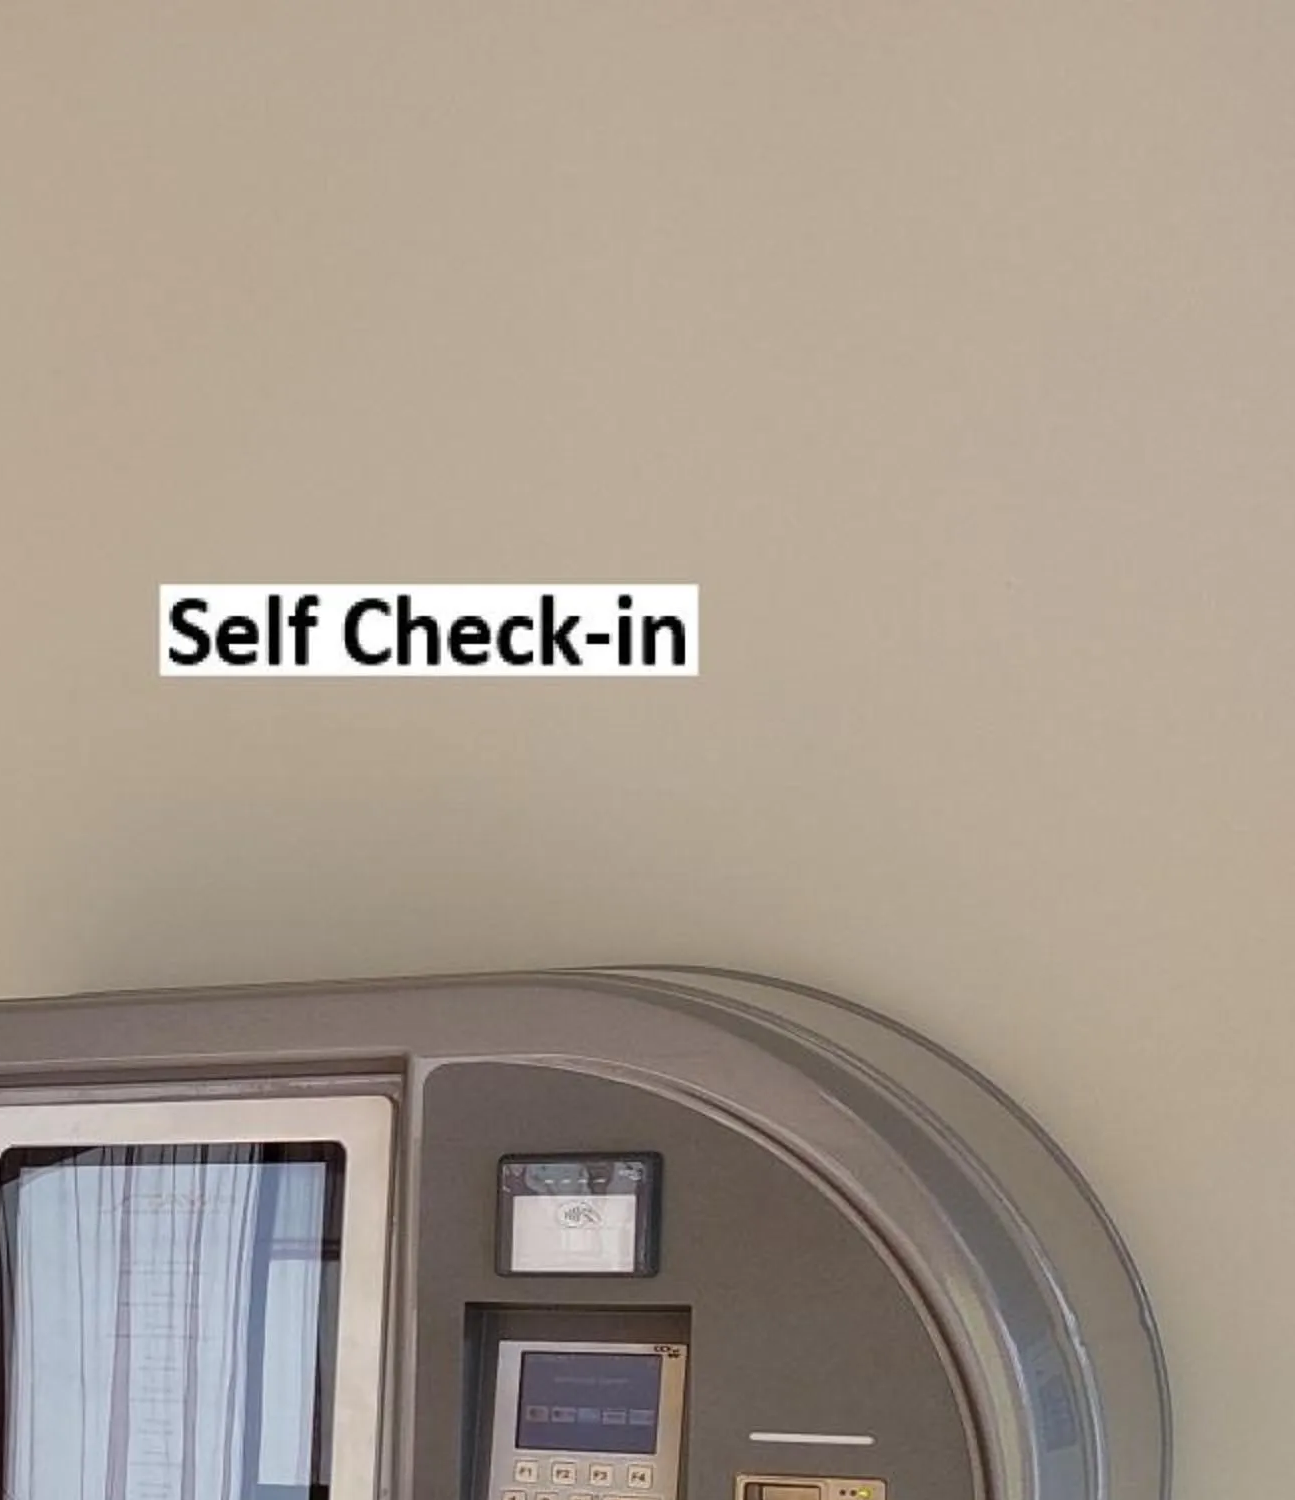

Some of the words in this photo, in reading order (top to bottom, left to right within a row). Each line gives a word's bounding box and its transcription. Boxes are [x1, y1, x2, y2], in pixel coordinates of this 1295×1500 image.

[518, 1466, 532, 1477] F1
[555, 1469, 570, 1479] F2
[631, 1472, 646, 1483] F4
